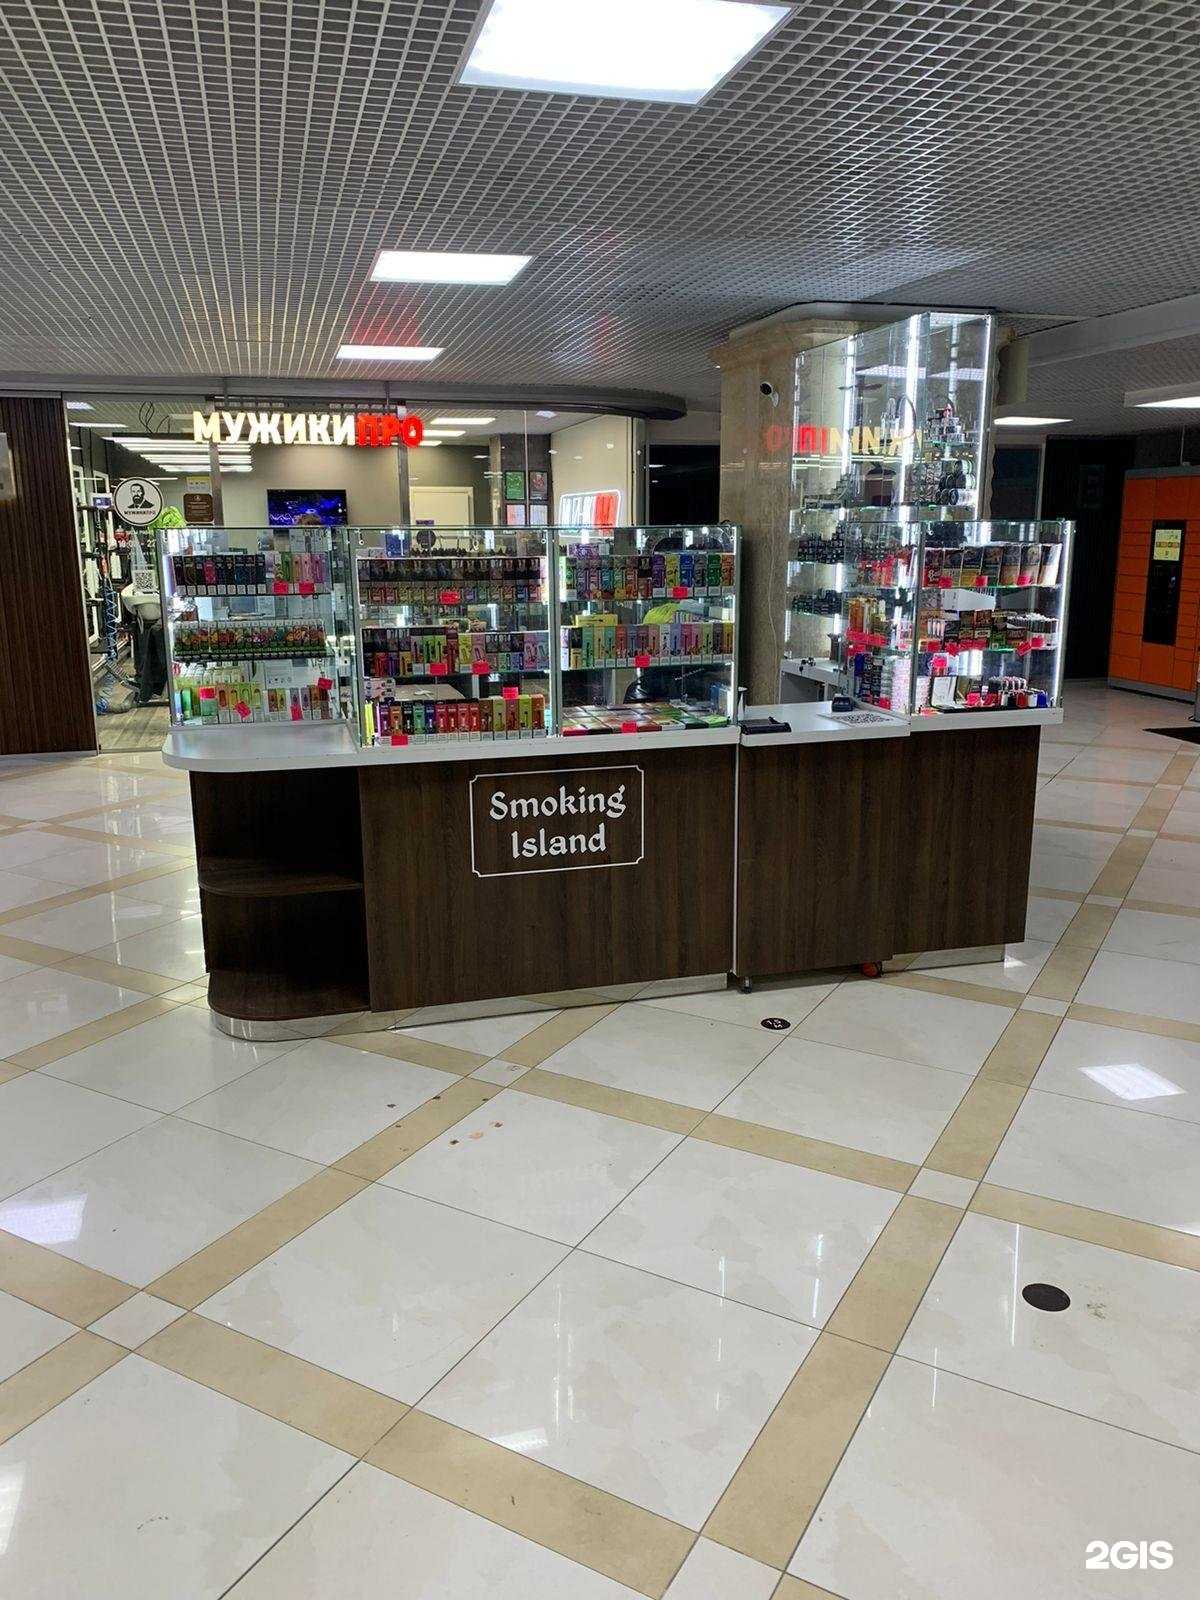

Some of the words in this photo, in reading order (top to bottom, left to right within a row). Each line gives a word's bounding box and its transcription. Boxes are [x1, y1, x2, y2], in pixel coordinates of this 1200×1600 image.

[193, 411, 424, 448] МУЖИКИПРО
[489, 784, 627, 821] Smoking
[511, 822, 607, 859] Island
